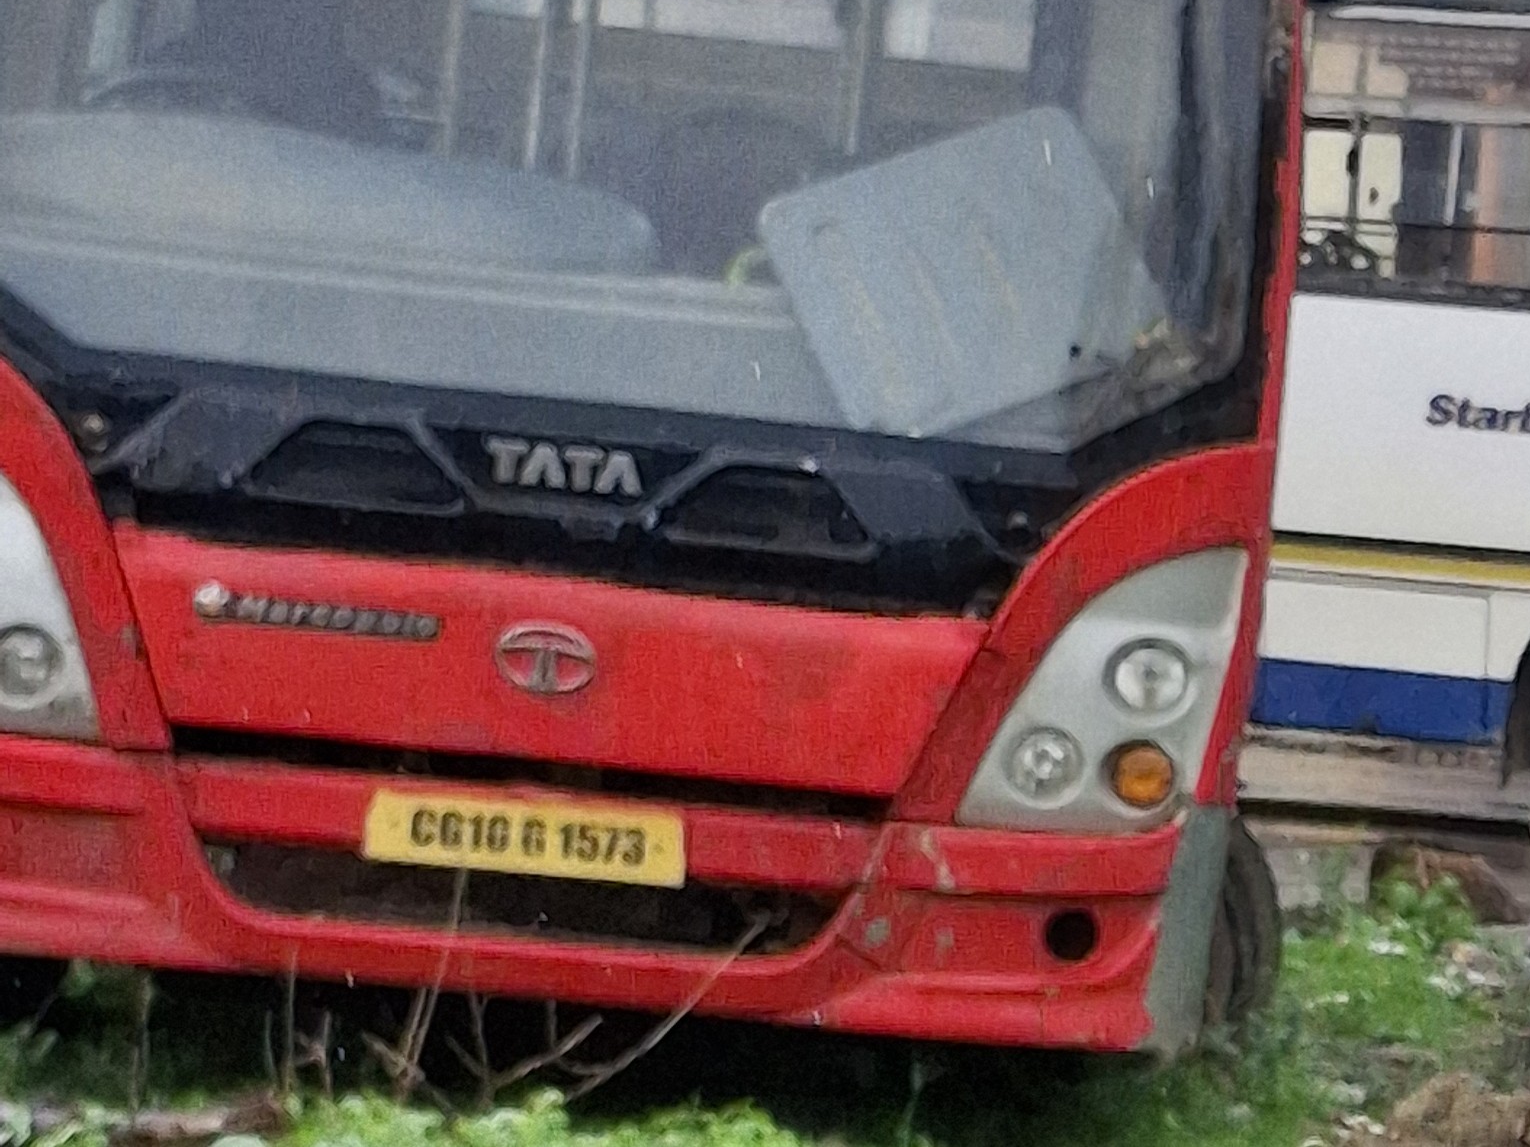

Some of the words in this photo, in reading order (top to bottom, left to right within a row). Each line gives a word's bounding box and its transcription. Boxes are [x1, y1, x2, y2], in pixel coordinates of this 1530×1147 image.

[483, 435, 643, 497] TATA
[410, 808, 512, 854] CG10
[559, 822, 647, 866] 1573
